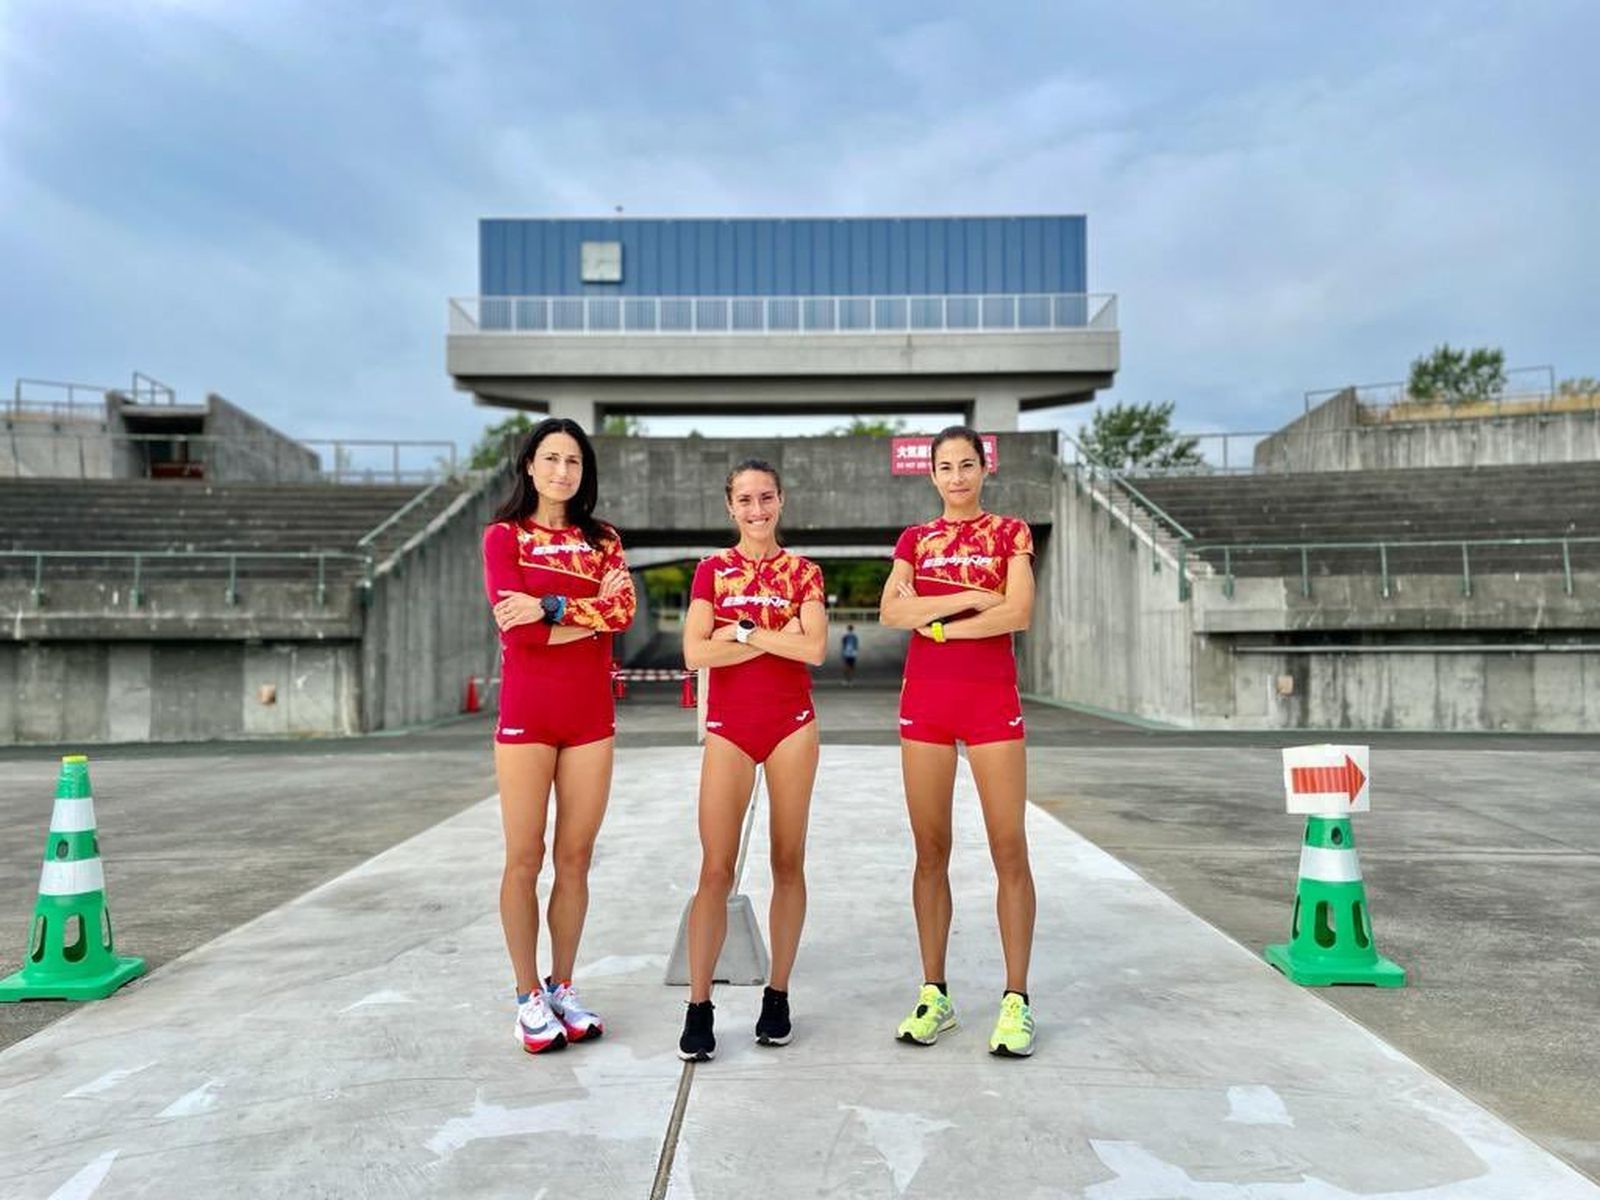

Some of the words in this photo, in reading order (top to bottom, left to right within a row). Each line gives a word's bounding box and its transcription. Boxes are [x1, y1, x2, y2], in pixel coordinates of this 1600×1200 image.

[532, 543, 593, 555] ESPAÑ
[922, 555, 992, 568] ESPAÑA
[722, 596, 790, 607] ESPAÑA
